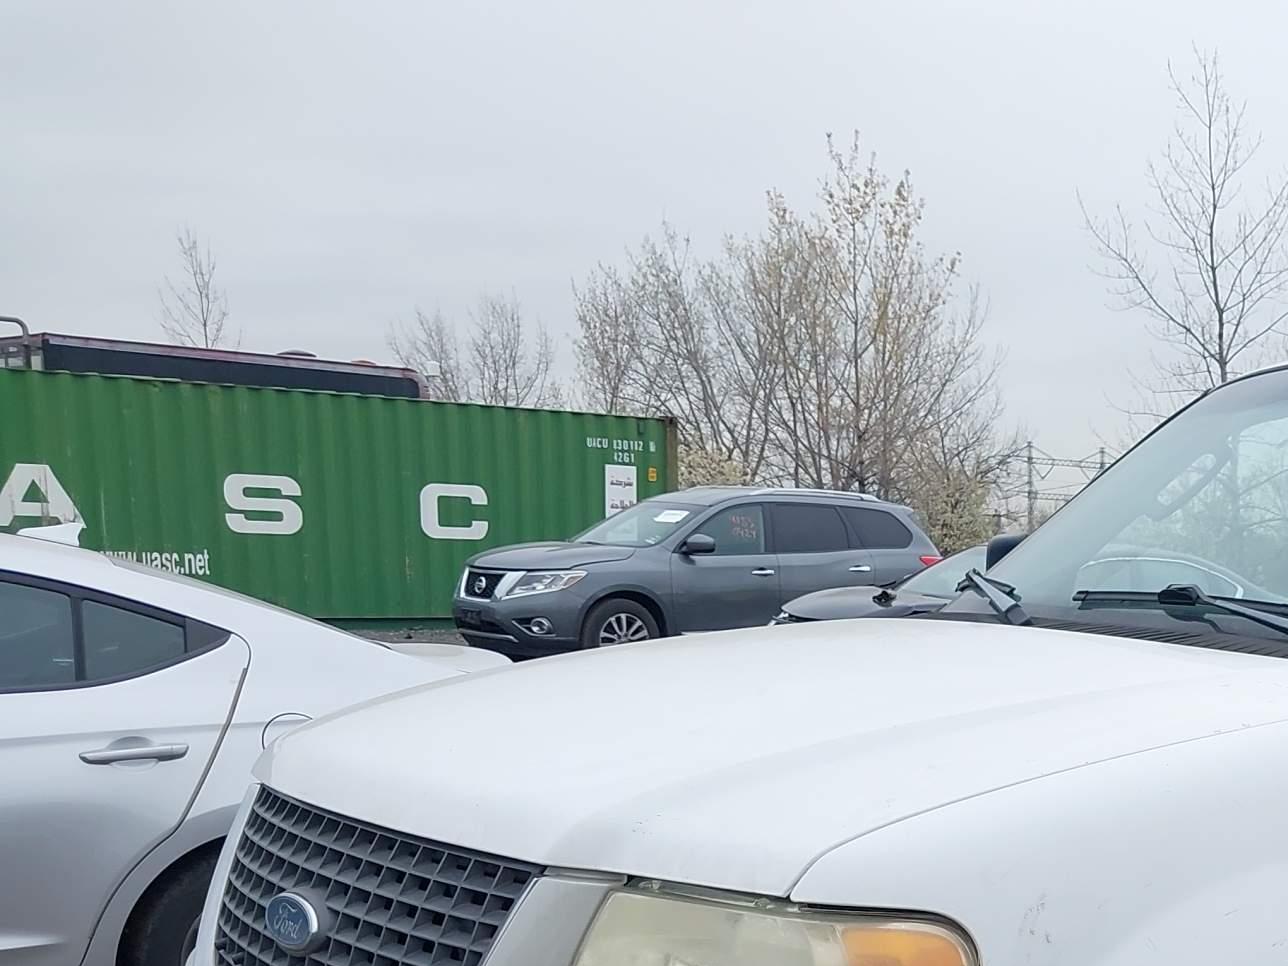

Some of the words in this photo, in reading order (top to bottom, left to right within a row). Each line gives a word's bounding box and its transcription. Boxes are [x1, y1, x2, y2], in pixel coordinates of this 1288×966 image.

[224, 474, 303, 535] S
[420, 483, 489, 540] C
[99, 549, 211, 576] uasc.net
[274, 902, 303, 940] Ford
